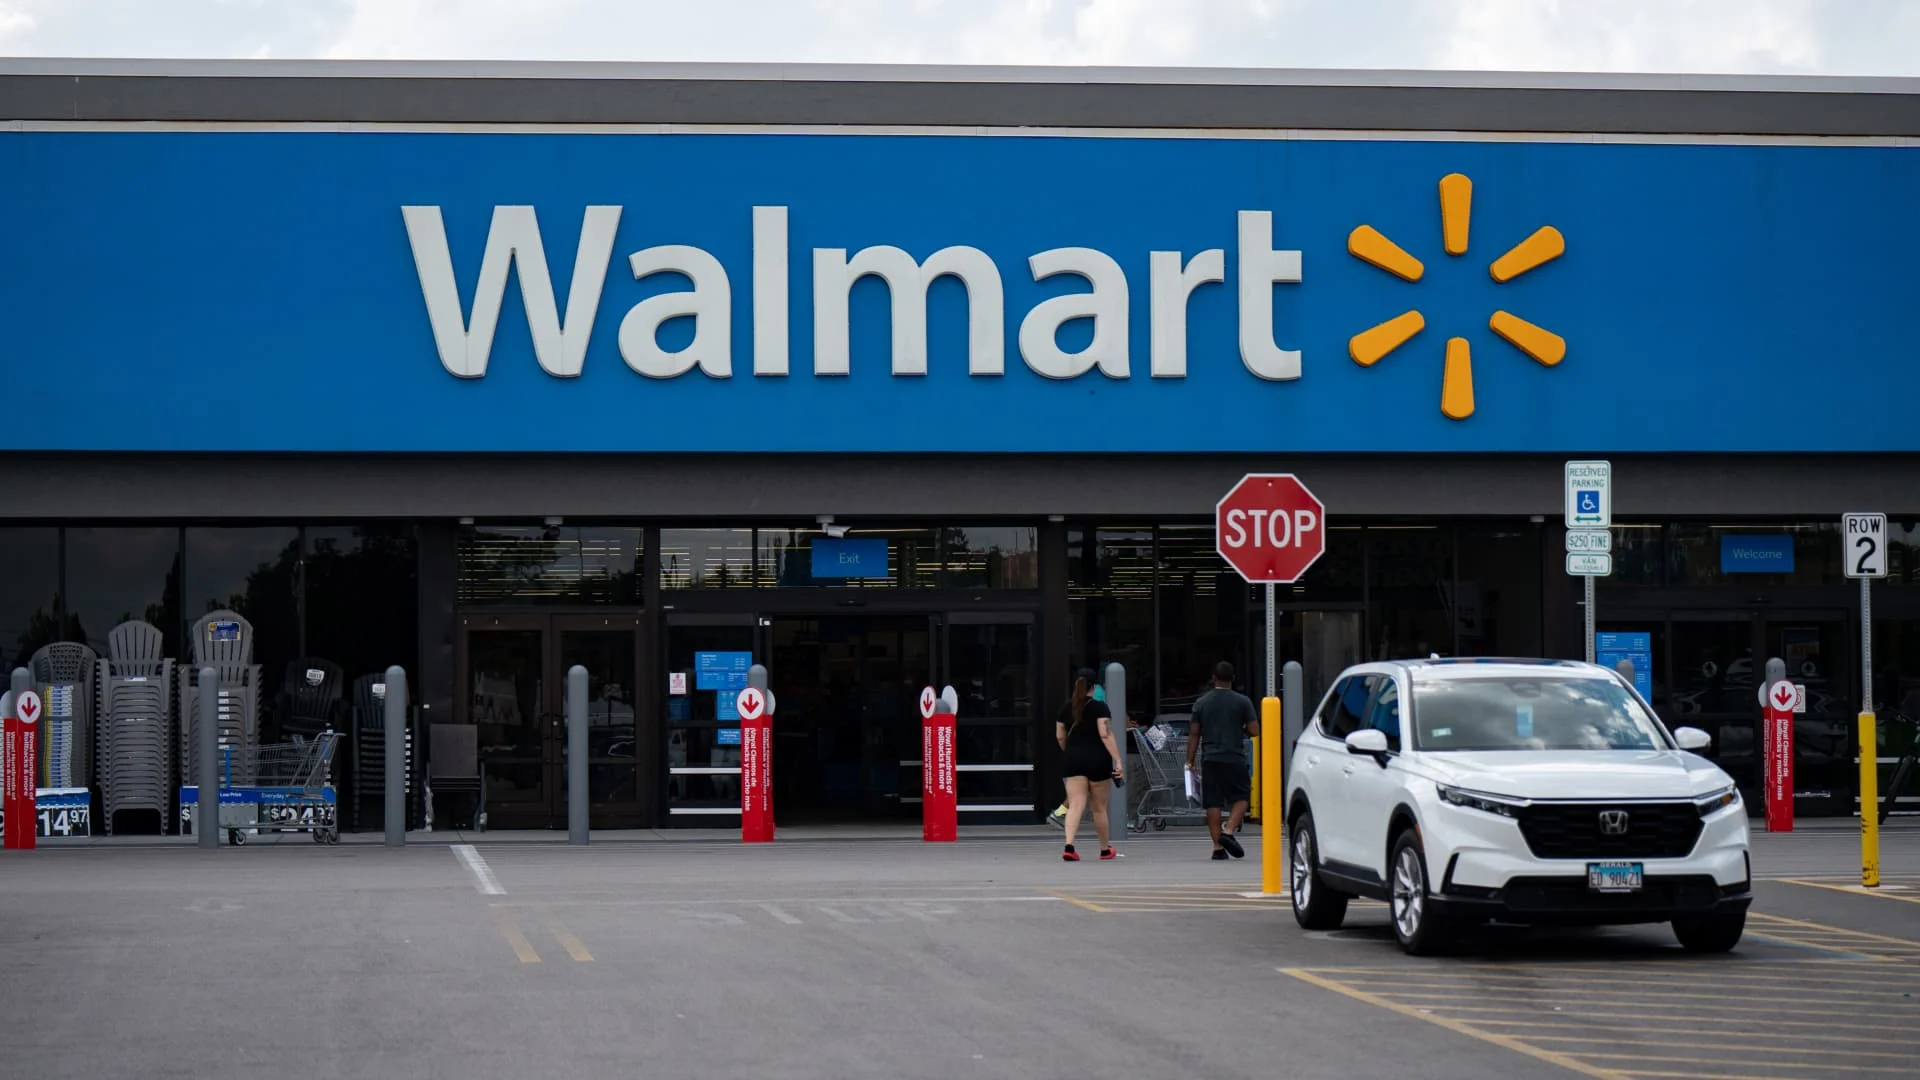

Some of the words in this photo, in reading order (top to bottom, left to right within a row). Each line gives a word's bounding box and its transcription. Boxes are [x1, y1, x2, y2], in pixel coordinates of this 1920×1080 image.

[400, 204, 1302, 381] Walmart
[1569, 467, 1608, 478] RESERVED
[1571, 479, 1605, 489] PARKING
[1224, 508, 1317, 549] STOP
[1848, 518, 1881, 534] ROW
[1568, 535, 1589, 548] $250
[1590, 535, 1608, 549] FINE
[839, 552, 860, 565] Exit
[1732, 547, 1784, 560] Welcome
[1856, 536, 1877, 574] 2
[945, 726, 953, 747] Wow!
[945, 747, 953, 785] Hundreds
[750, 777, 757, 787] de
[945, 785, 953, 794] of
[1591, 872, 1603, 886] ED
